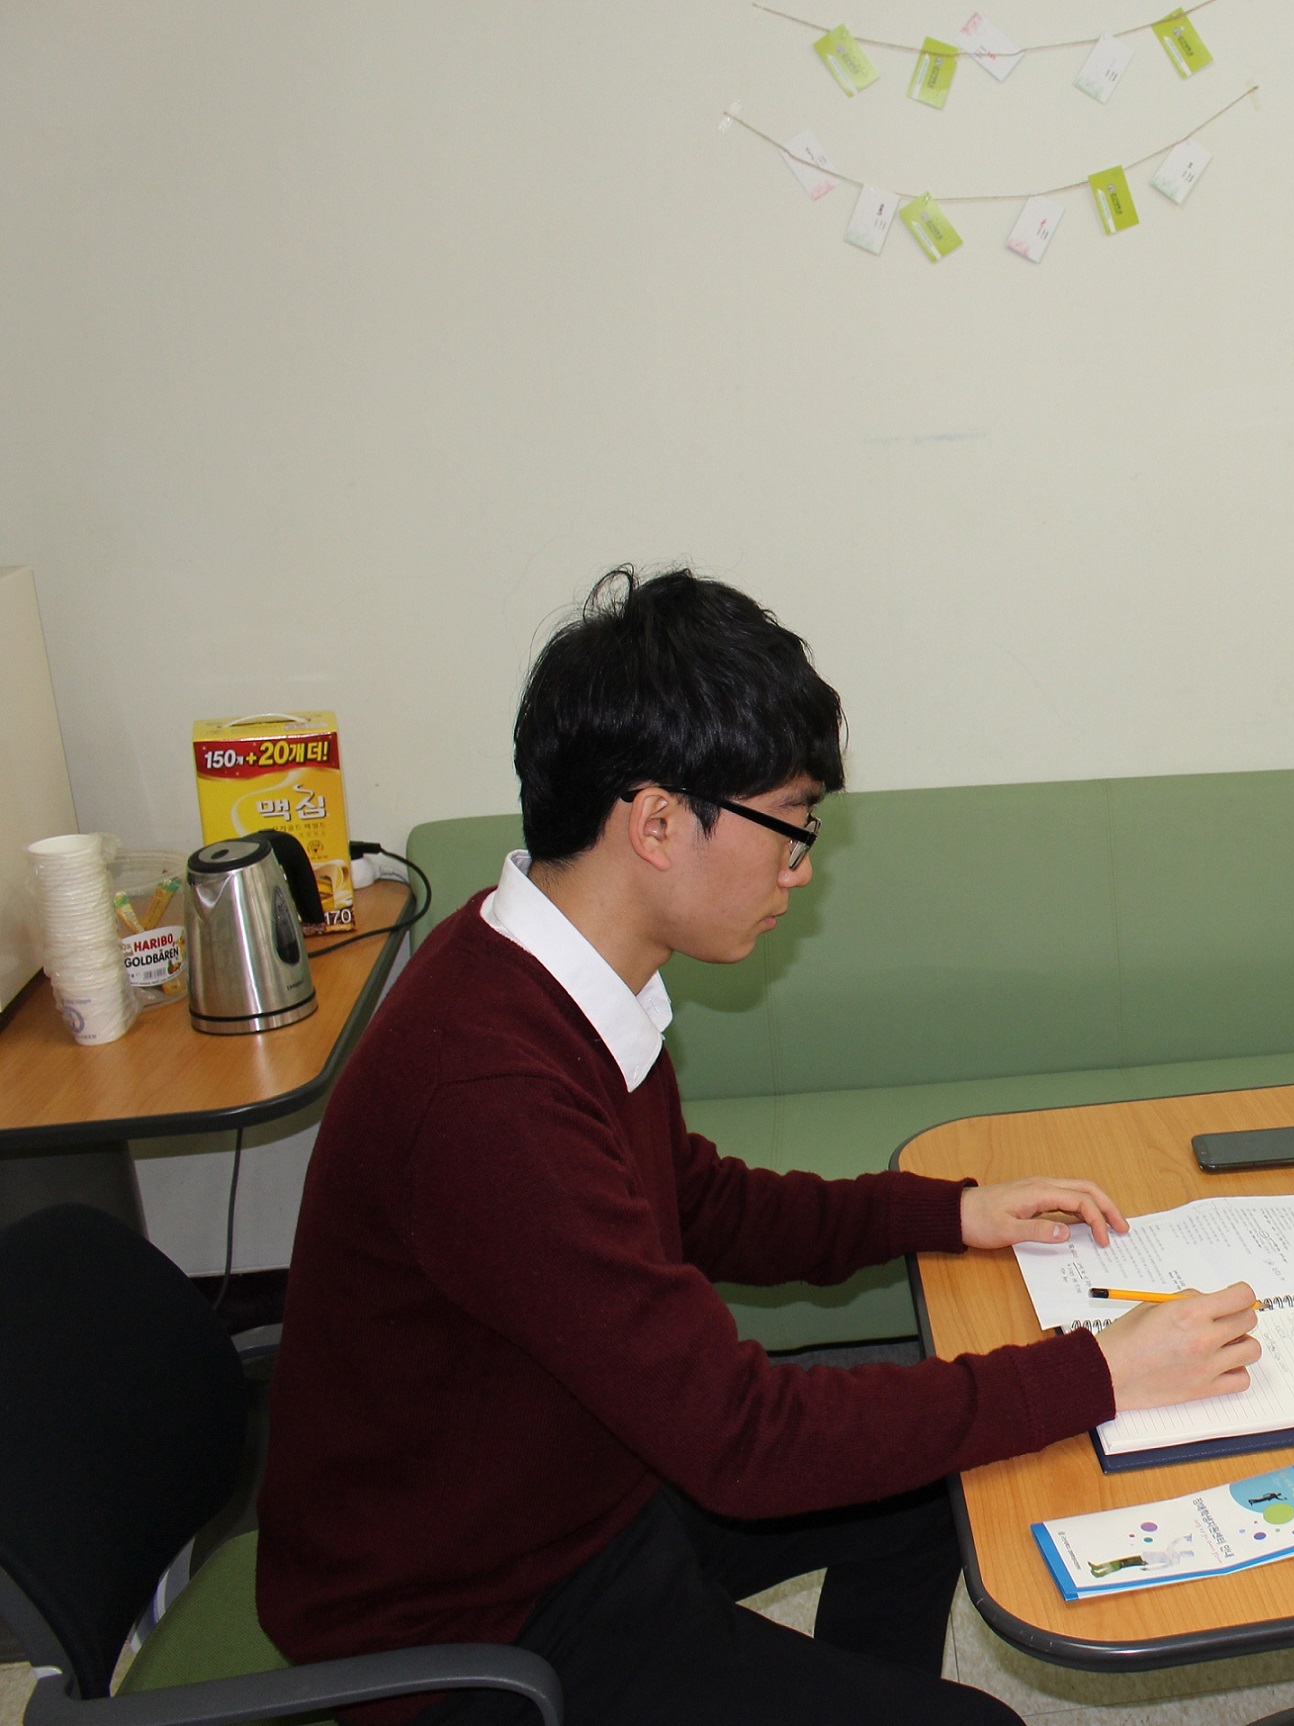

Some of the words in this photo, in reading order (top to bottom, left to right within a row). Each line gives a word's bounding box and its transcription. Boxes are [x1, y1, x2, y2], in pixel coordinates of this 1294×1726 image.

[256, 784, 327, 821] 맥심
[324, 908, 352, 926] 170
[133, 933, 174, 953] HARIBO
[124, 946, 179, 969] GOLDBÄREN
